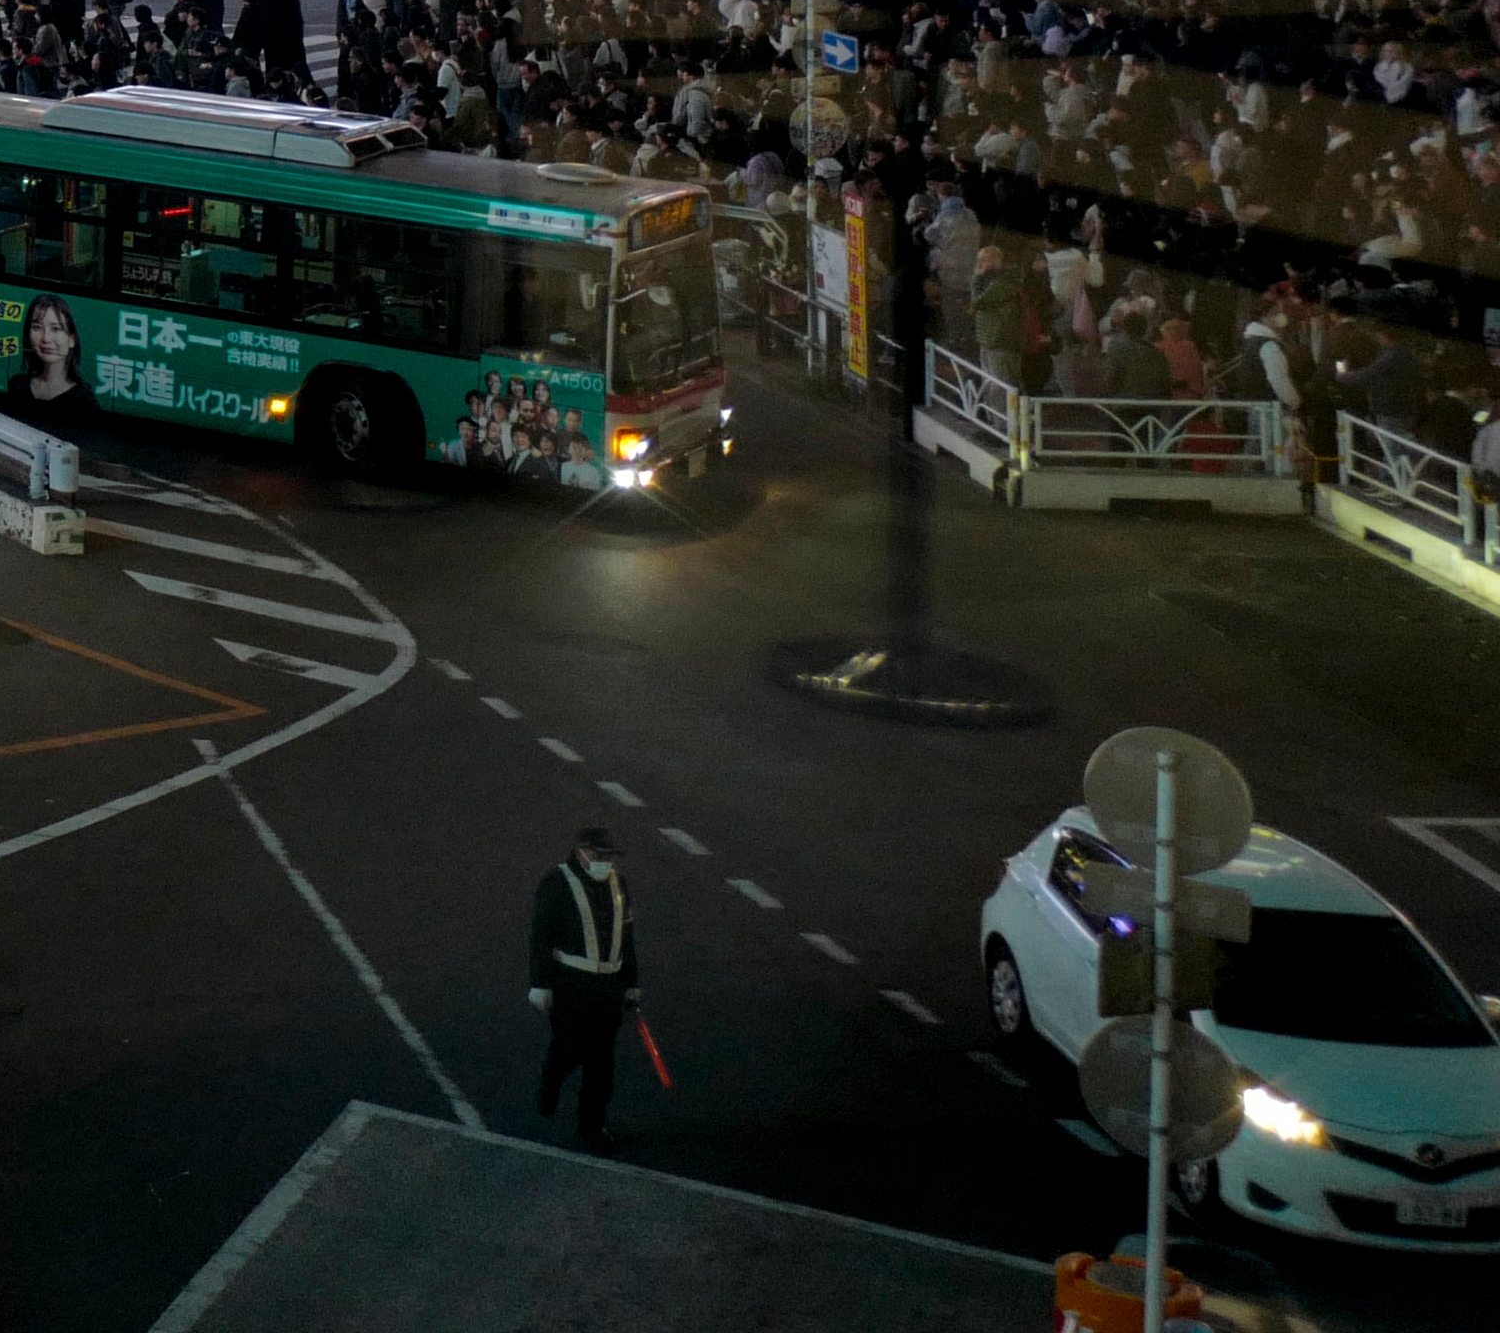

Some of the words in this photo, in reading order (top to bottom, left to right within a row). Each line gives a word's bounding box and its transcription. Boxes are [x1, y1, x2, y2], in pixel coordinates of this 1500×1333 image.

[117, 308, 224, 350] 日本一
[95, 353, 176, 407] 東進
